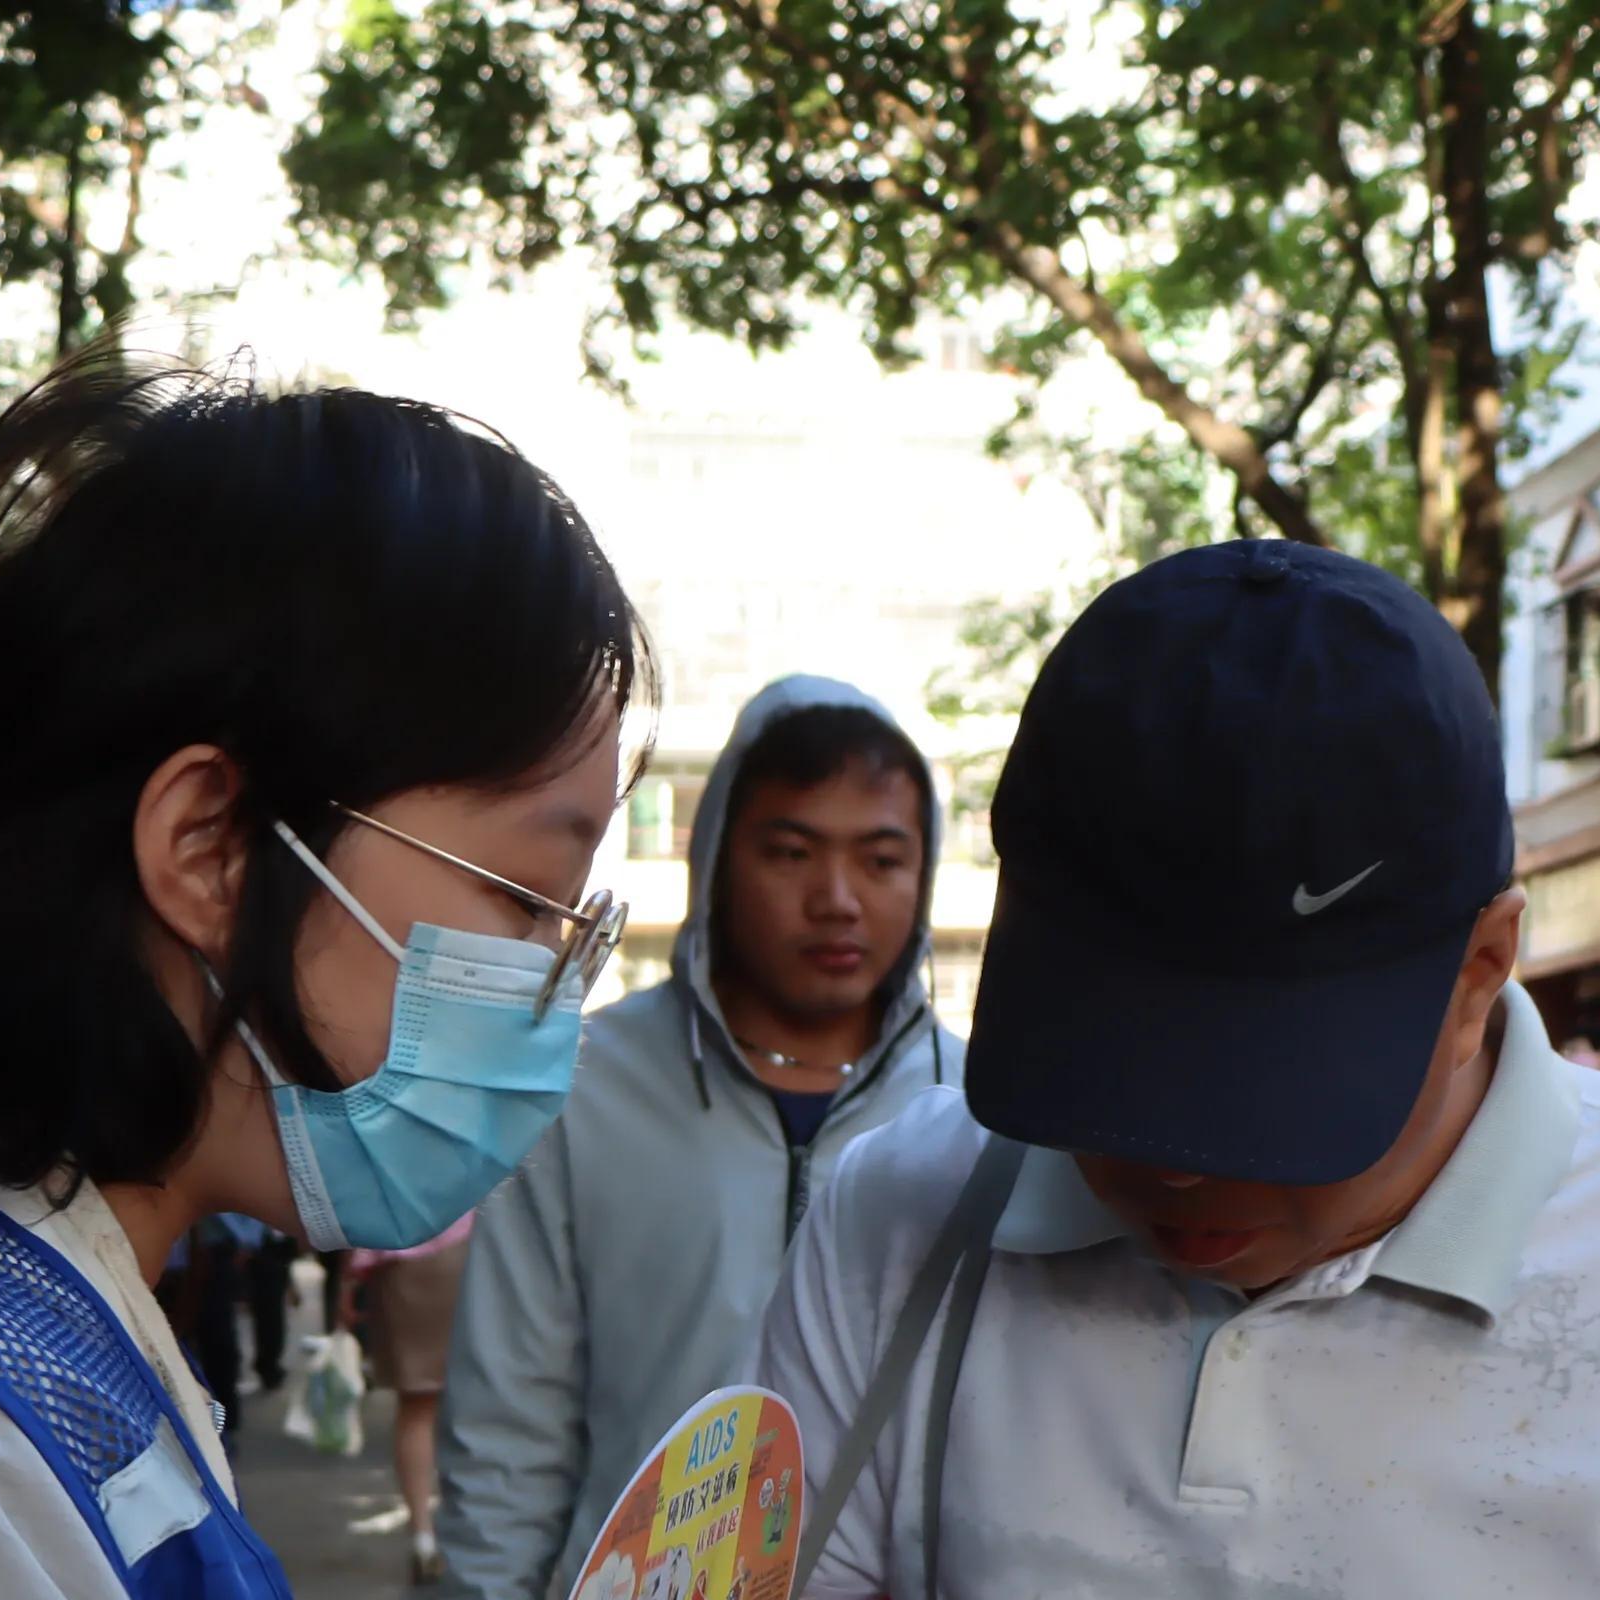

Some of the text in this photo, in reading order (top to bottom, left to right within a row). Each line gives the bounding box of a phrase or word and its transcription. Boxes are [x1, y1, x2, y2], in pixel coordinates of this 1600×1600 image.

[685, 1408, 740, 1477] AIDS
[664, 1462, 741, 1534] 预防艾滋病
